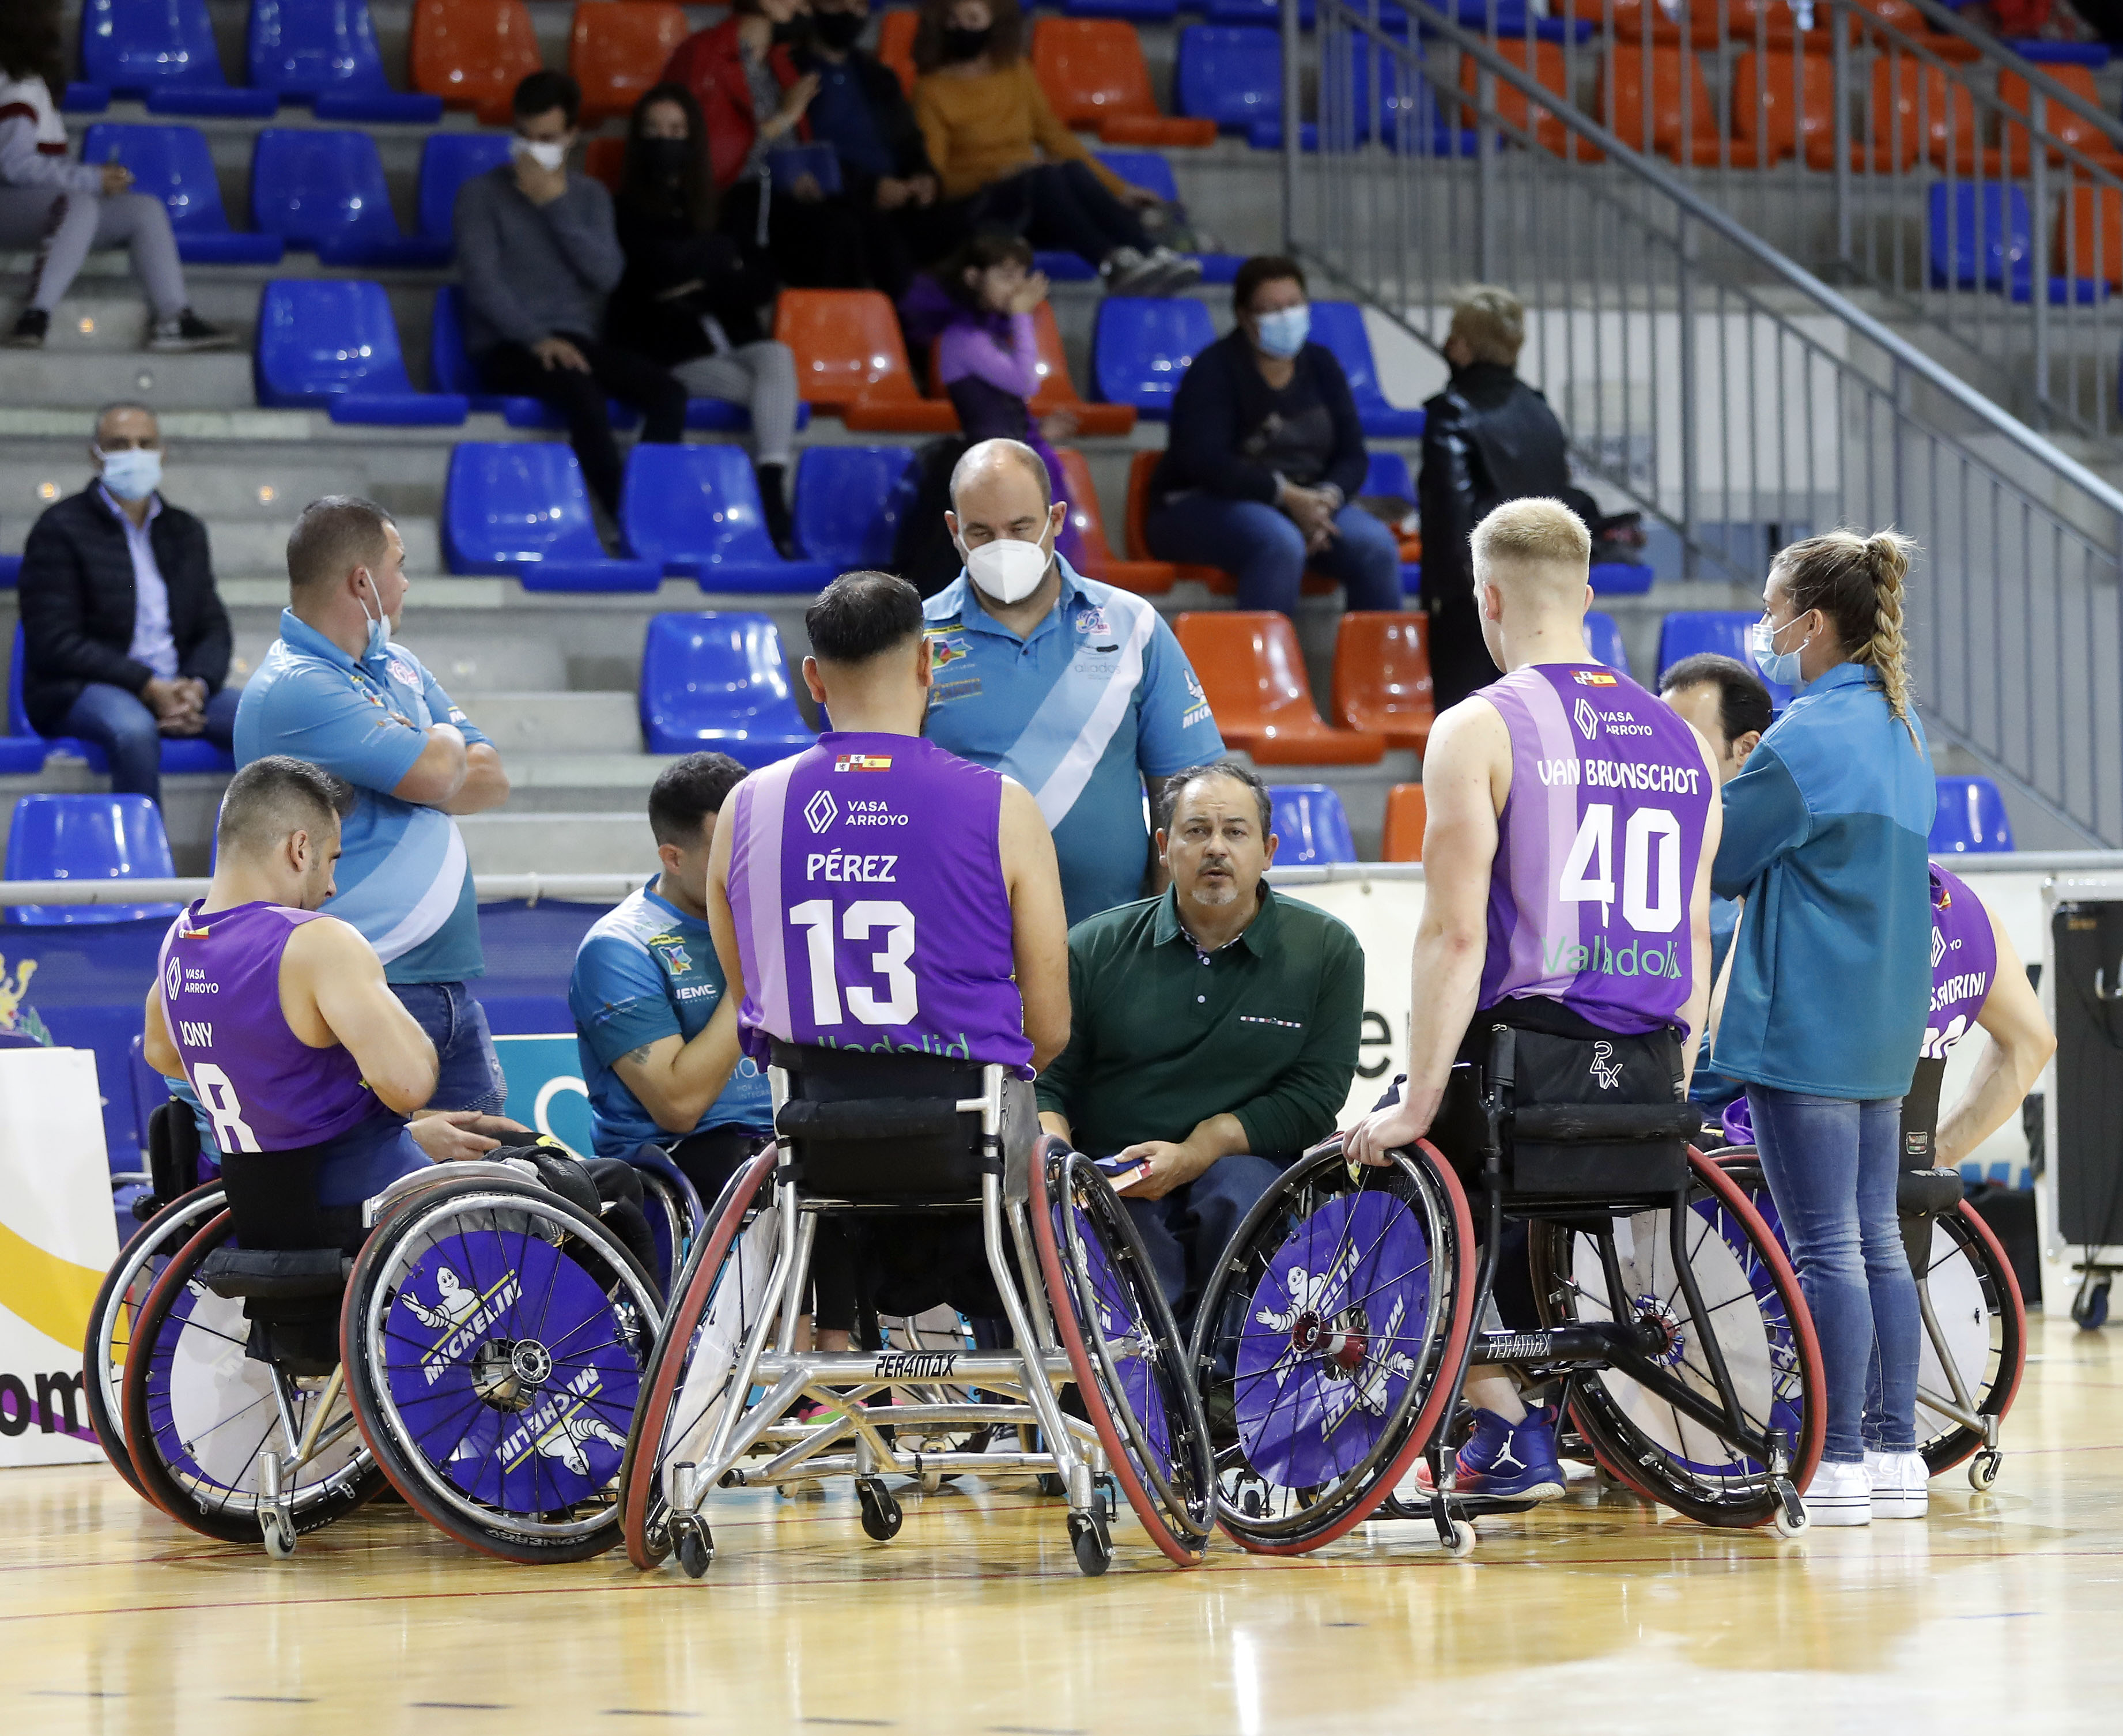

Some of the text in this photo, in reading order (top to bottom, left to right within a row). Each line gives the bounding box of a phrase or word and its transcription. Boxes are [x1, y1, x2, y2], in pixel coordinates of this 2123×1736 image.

[1599, 712, 1634, 723] VASA
[1606, 723, 1653, 737] ARROYO
[1537, 758, 1699, 795] VAN BRUNSCHOT
[847, 801, 889, 812] VASA
[845, 814, 909, 827] ARROYO
[807, 848, 898, 882] PÉREZ
[1559, 803, 1683, 933] 40
[186, 968, 205, 980] VASA
[789, 899, 919, 1026] 13
[184, 982, 219, 994] ARROYO
[179, 1020, 213, 1048] JONY
[424, 1278, 523, 1386] MICHELIN
[874, 1354, 957, 1378] PER4MAX
[494, 1363, 600, 1466] MICHELIN
